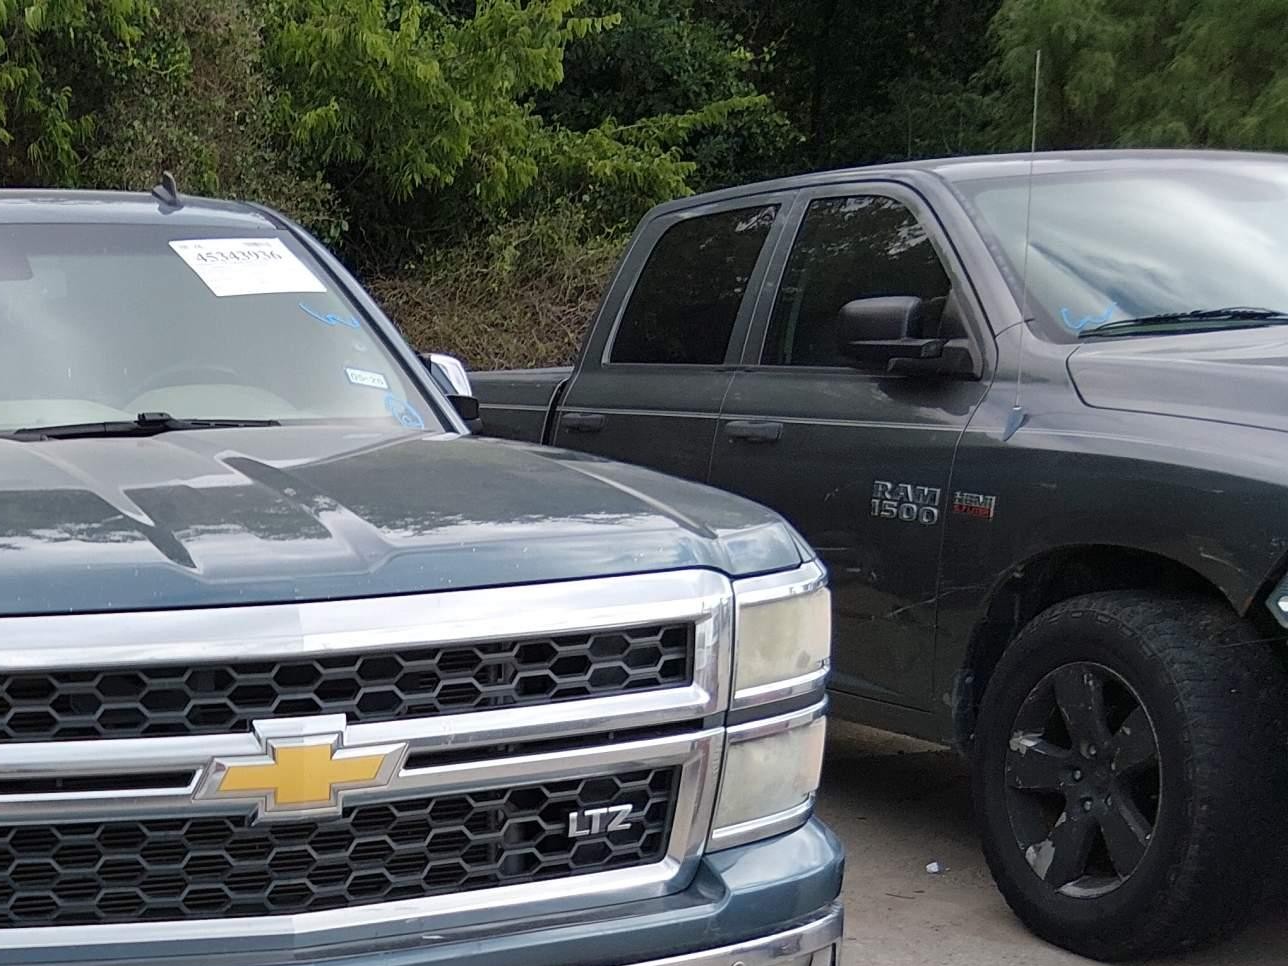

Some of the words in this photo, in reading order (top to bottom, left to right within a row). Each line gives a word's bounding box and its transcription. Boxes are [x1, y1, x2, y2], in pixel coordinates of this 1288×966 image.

[196, 250, 283, 263] 45343936
[872, 480, 941, 506] RAM
[871, 498, 939, 525] 1500
[568, 803, 633, 838] LTZ
